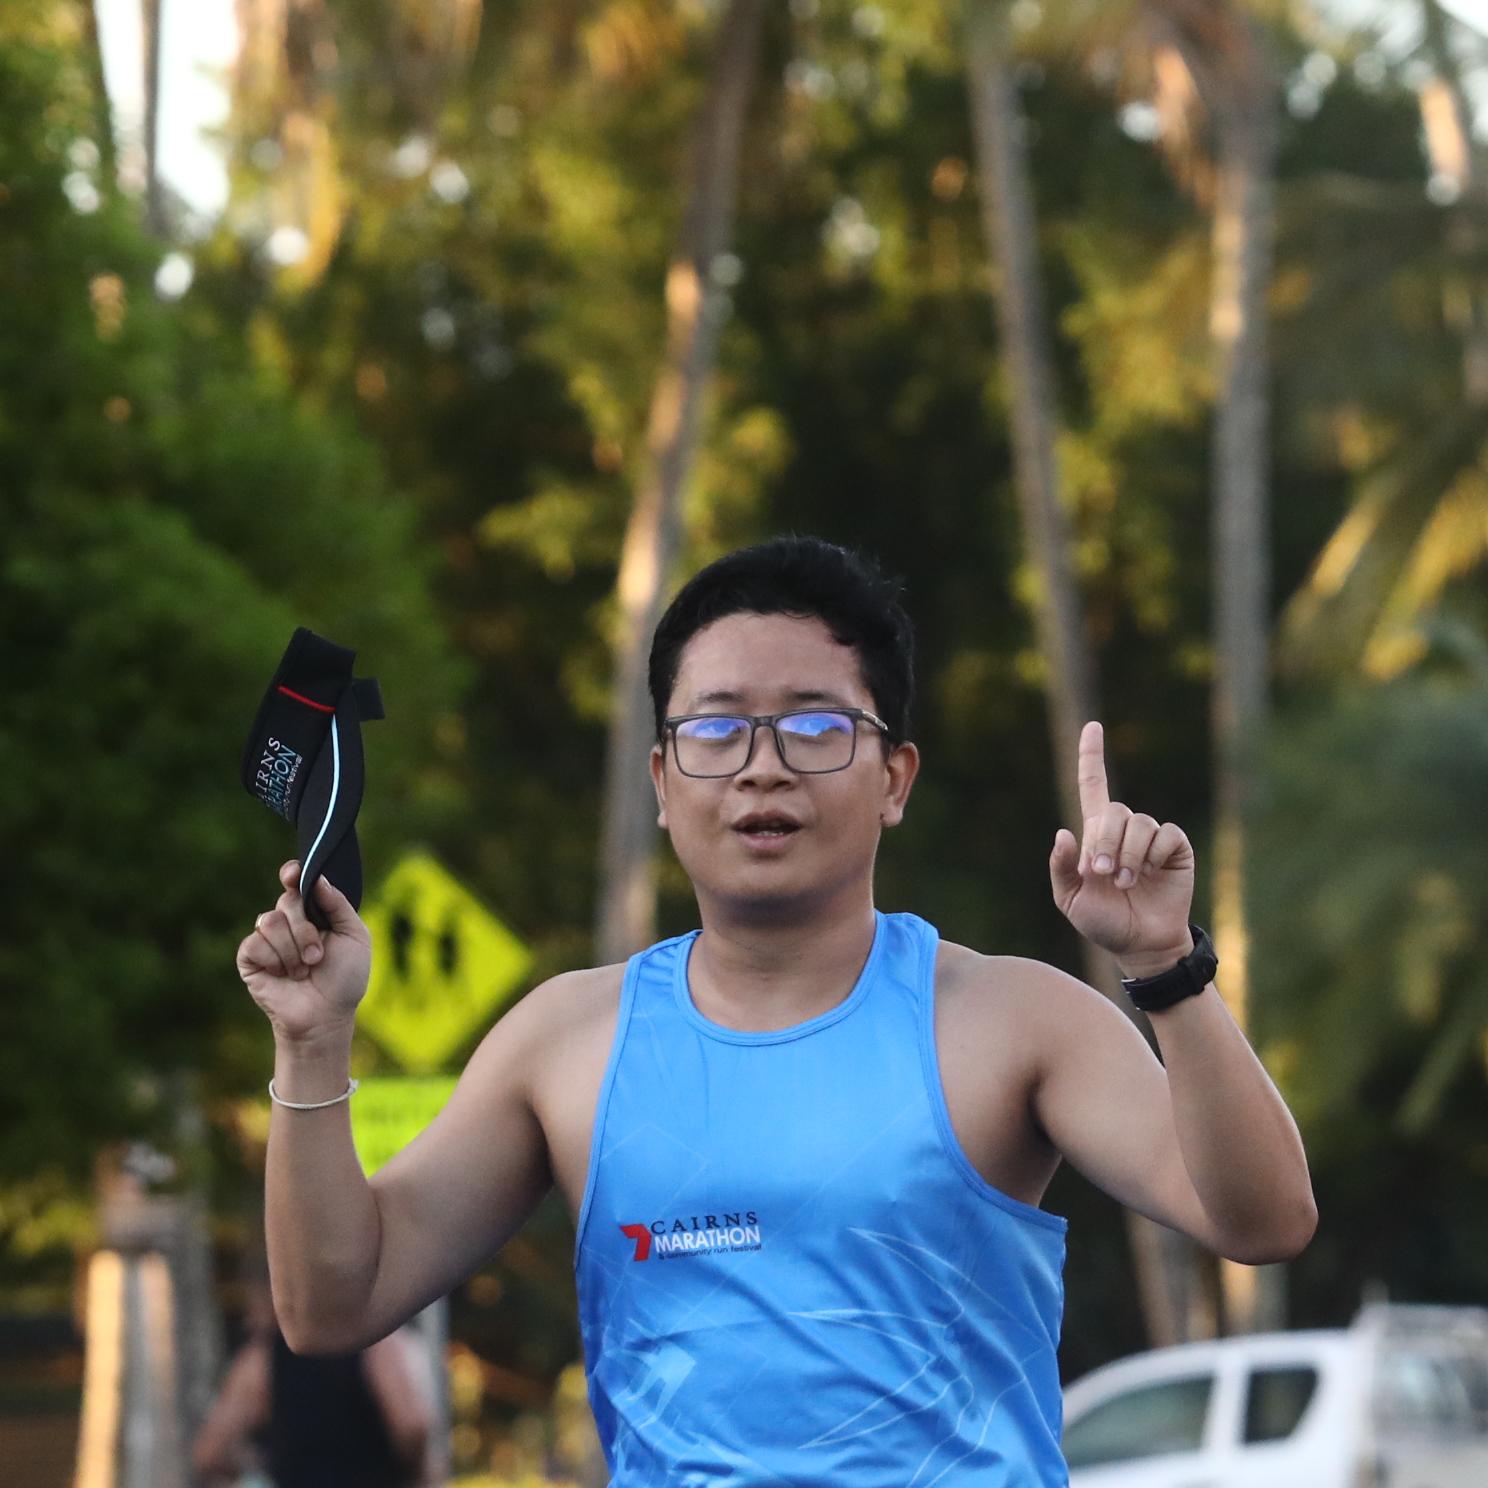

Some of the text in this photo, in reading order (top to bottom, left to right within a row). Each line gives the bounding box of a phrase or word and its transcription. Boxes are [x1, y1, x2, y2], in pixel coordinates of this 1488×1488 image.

[254, 737, 281, 806] IRNS
[650, 1211, 758, 1235] CAIRNS
[654, 1226, 761, 1252] MARATHON
